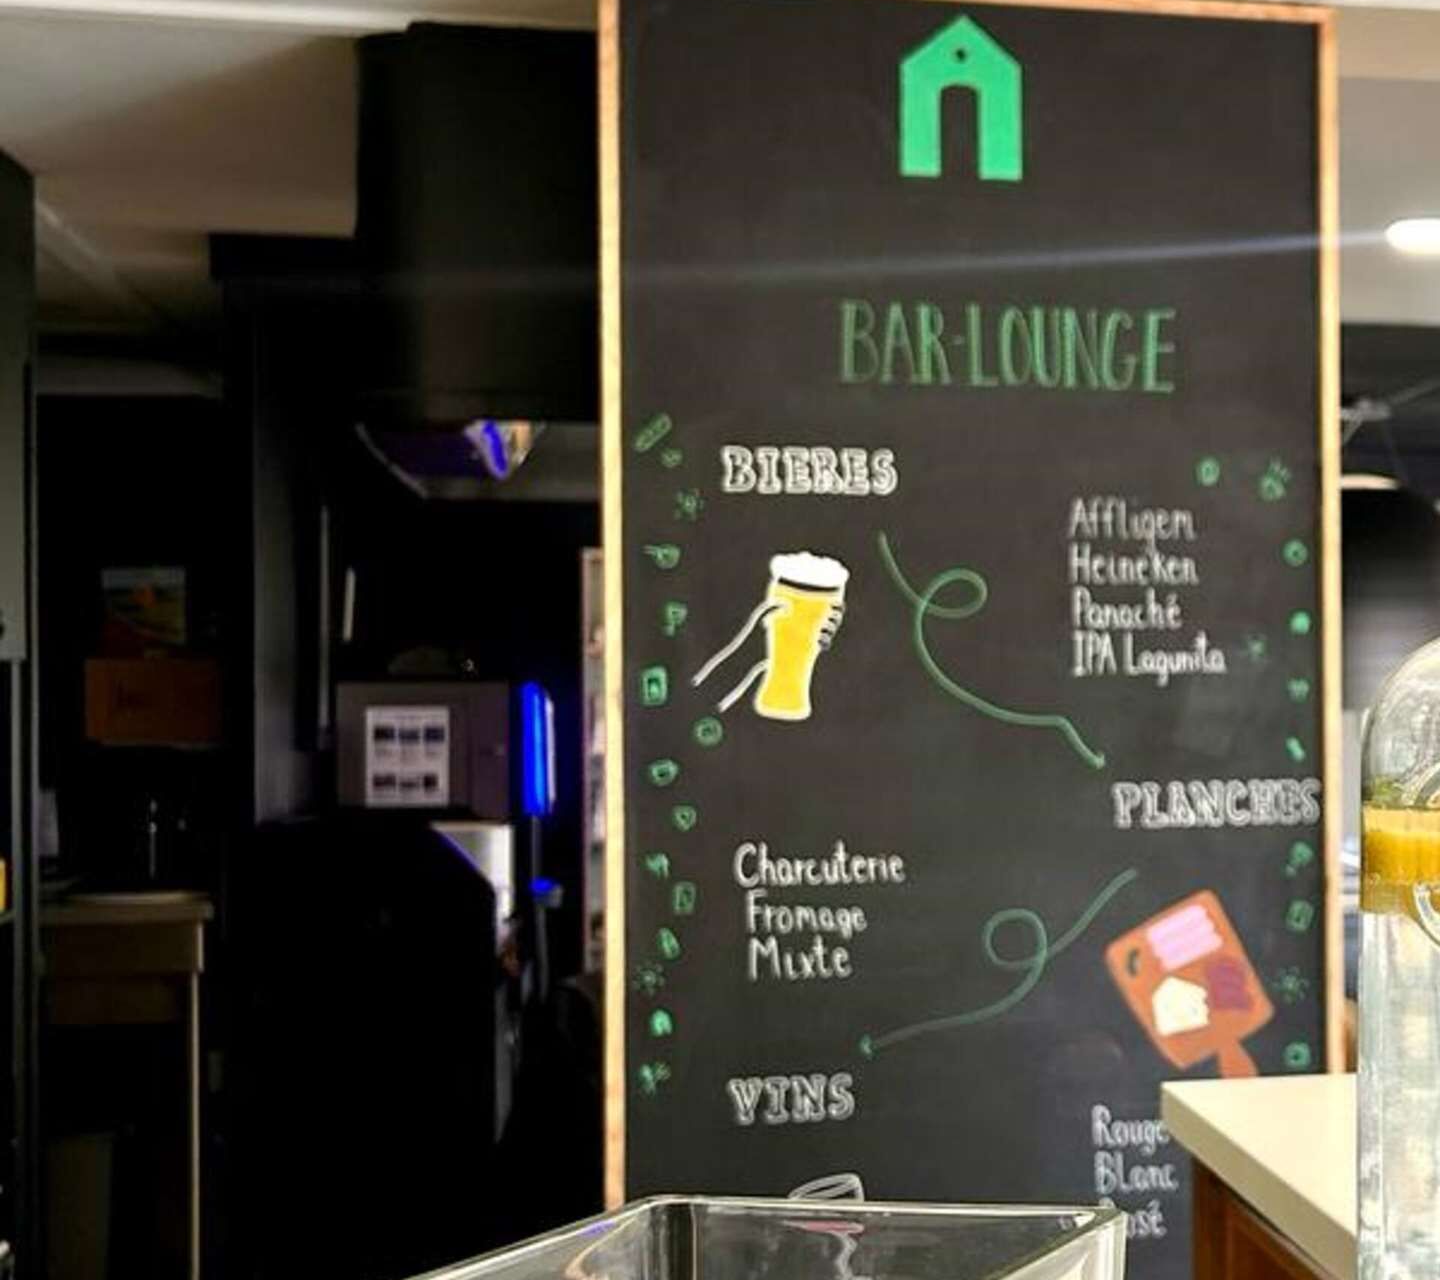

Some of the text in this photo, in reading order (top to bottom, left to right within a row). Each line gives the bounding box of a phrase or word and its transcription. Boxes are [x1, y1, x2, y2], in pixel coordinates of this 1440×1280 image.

[839, 298, 1177, 394] BAR-LOUNGE
[721, 444, 898, 496] BIERES
[1069, 541, 1199, 586] Heineken
[1072, 585, 1183, 629] Panaché
[1073, 629, 1117, 677] IPA
[1111, 778, 1323, 829] PLANCHES
[734, 838, 906, 888] Charcuterie
[745, 887, 868, 939] Fromage
[748, 935, 852, 981] Mixte
[727, 1072, 855, 1125] VINS
